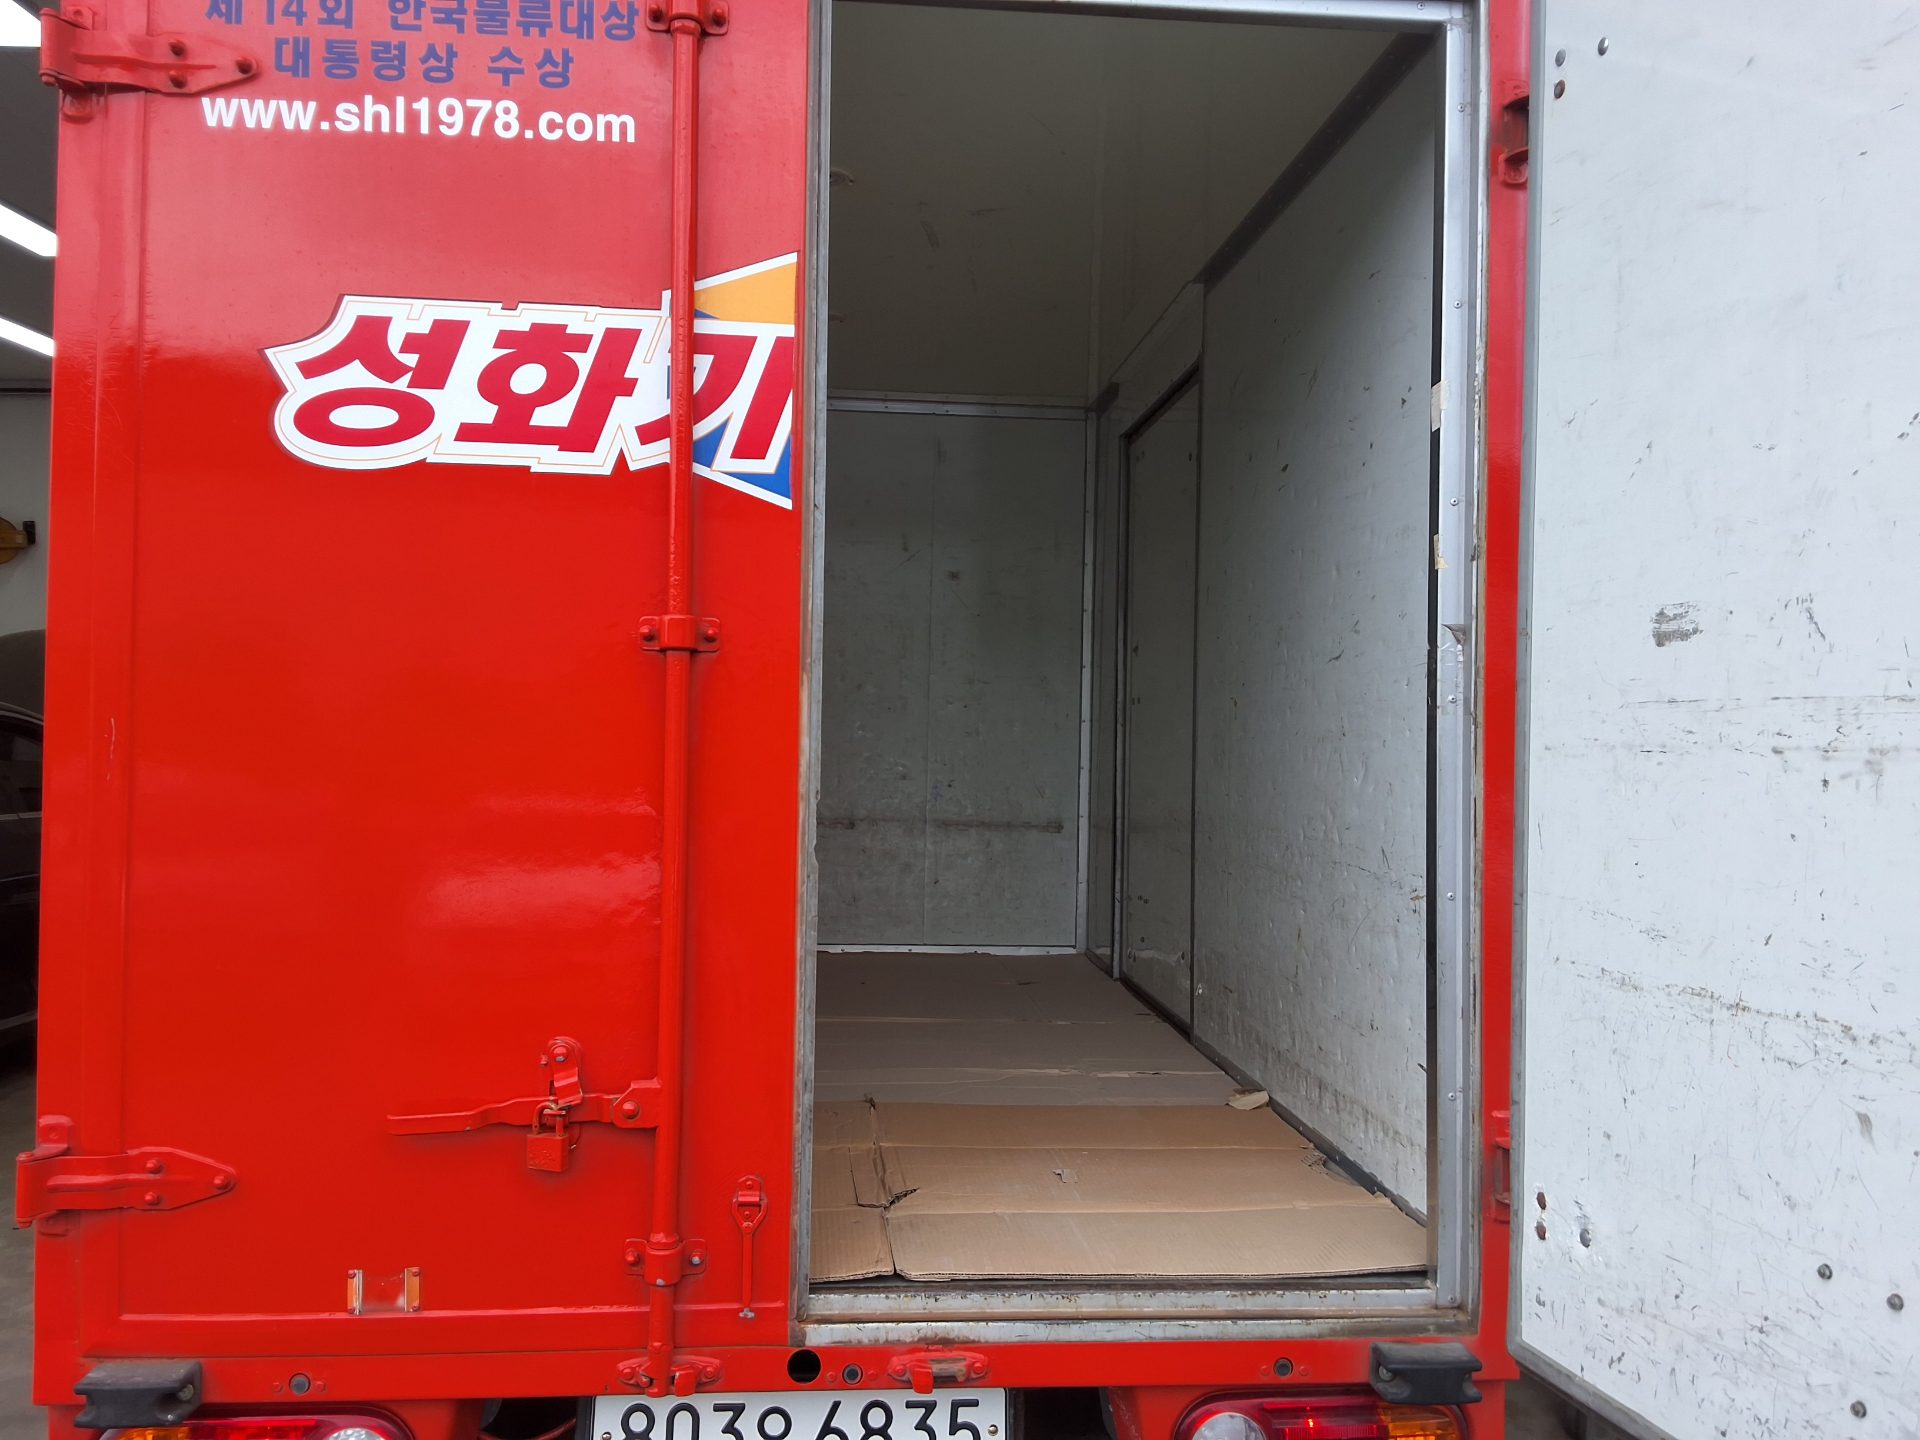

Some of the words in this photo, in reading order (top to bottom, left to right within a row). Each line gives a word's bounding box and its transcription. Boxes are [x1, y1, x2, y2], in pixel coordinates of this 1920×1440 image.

[274, 36, 458, 83] 대통령상
[487, 47, 574, 89] 수상
[201, 95, 636, 143] www.shl1978.com
[815, 1398, 980, 1440] 6835
